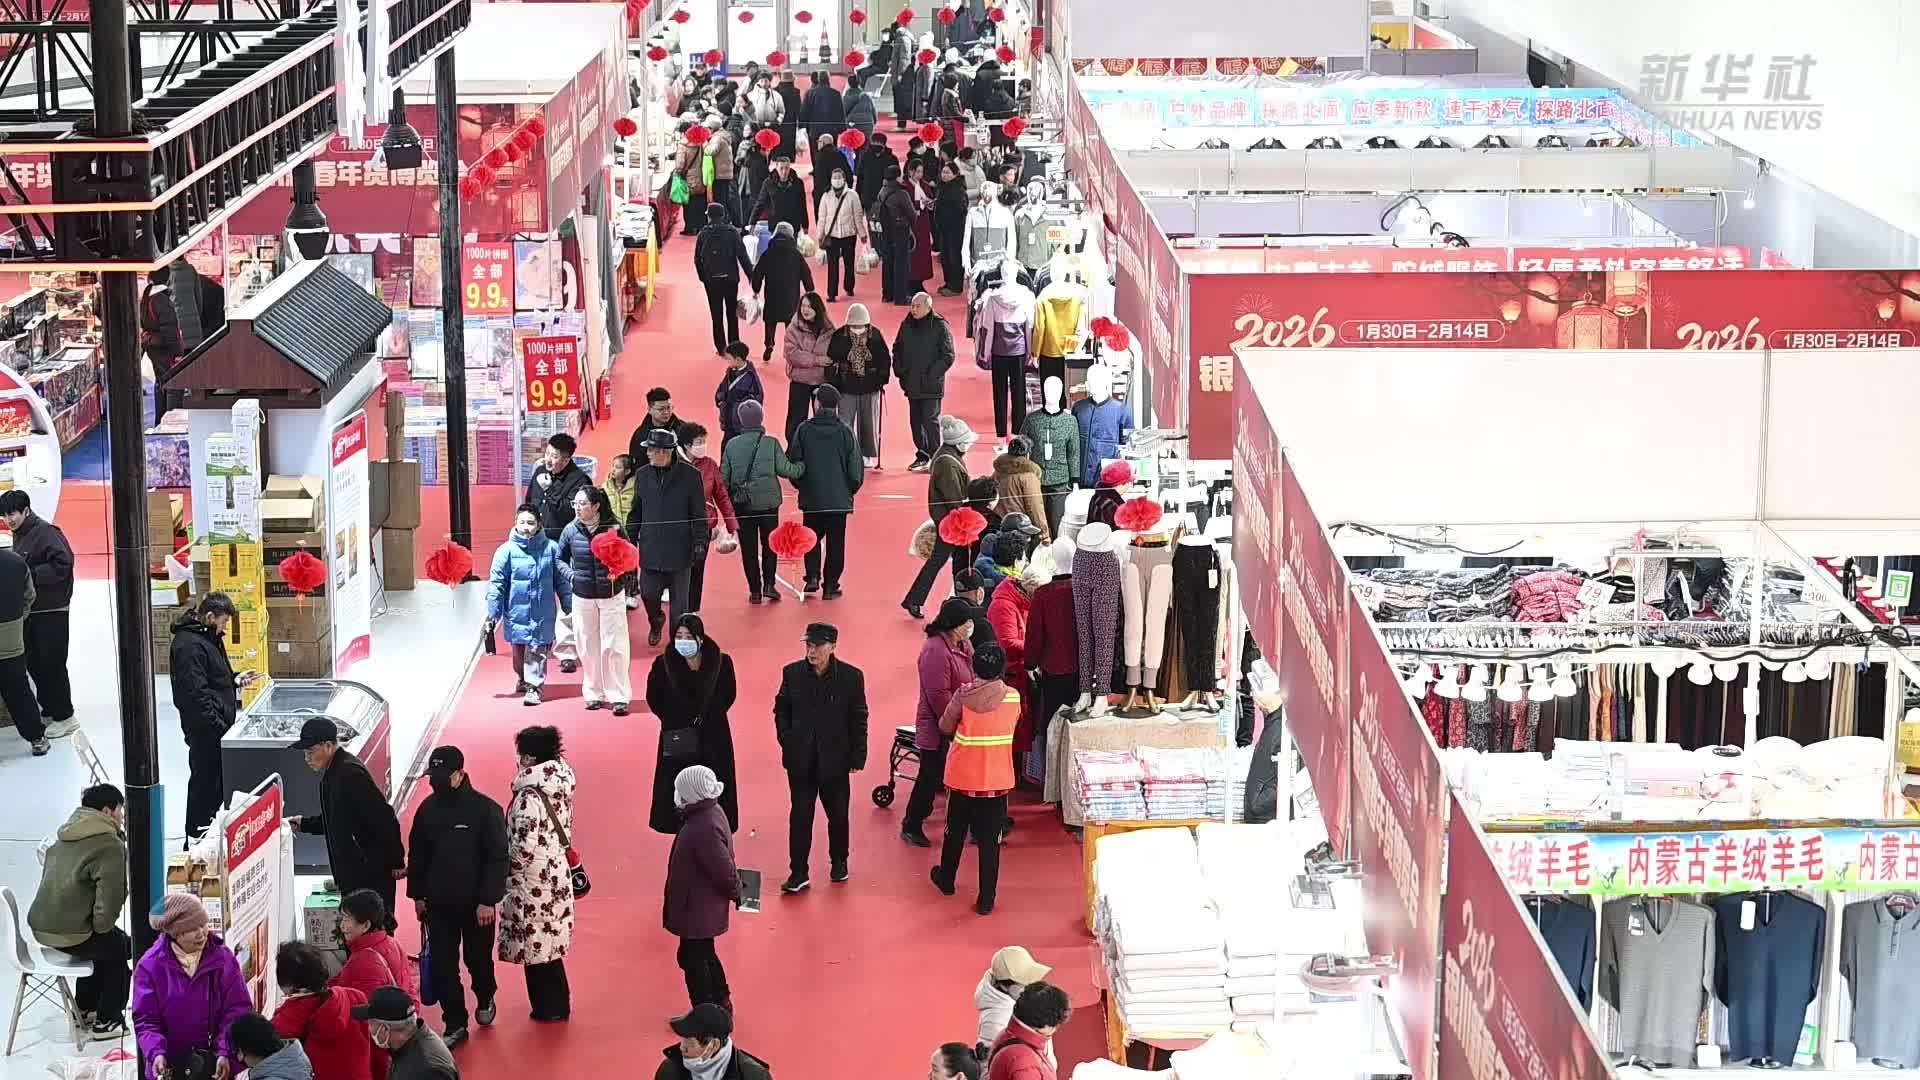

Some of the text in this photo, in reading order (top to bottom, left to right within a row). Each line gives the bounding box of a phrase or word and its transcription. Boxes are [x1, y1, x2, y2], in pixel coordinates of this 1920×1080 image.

[1352, 100, 1431, 119] 应季新款
[1444, 99, 1523, 120] 速干透气
[1536, 99, 1615, 119] 探路北面
[466, 248, 509, 260] 1000片拼图
[472, 263, 503, 280] 全部
[1230, 306, 1488, 348] 2026 1月30日-2月14日
[1676, 317, 1900, 350] 2026 1月30日-2月14日
[527, 341, 573, 355] 1000片拼图
[535, 358, 569, 377] 全部
[1198, 355, 1234, 392] 银
[530, 378, 577, 408] 9.9元
[1628, 834, 1824, 887] 内蒙古羊绒羊毛
[1859, 833, 1920, 881] 内蒙古
